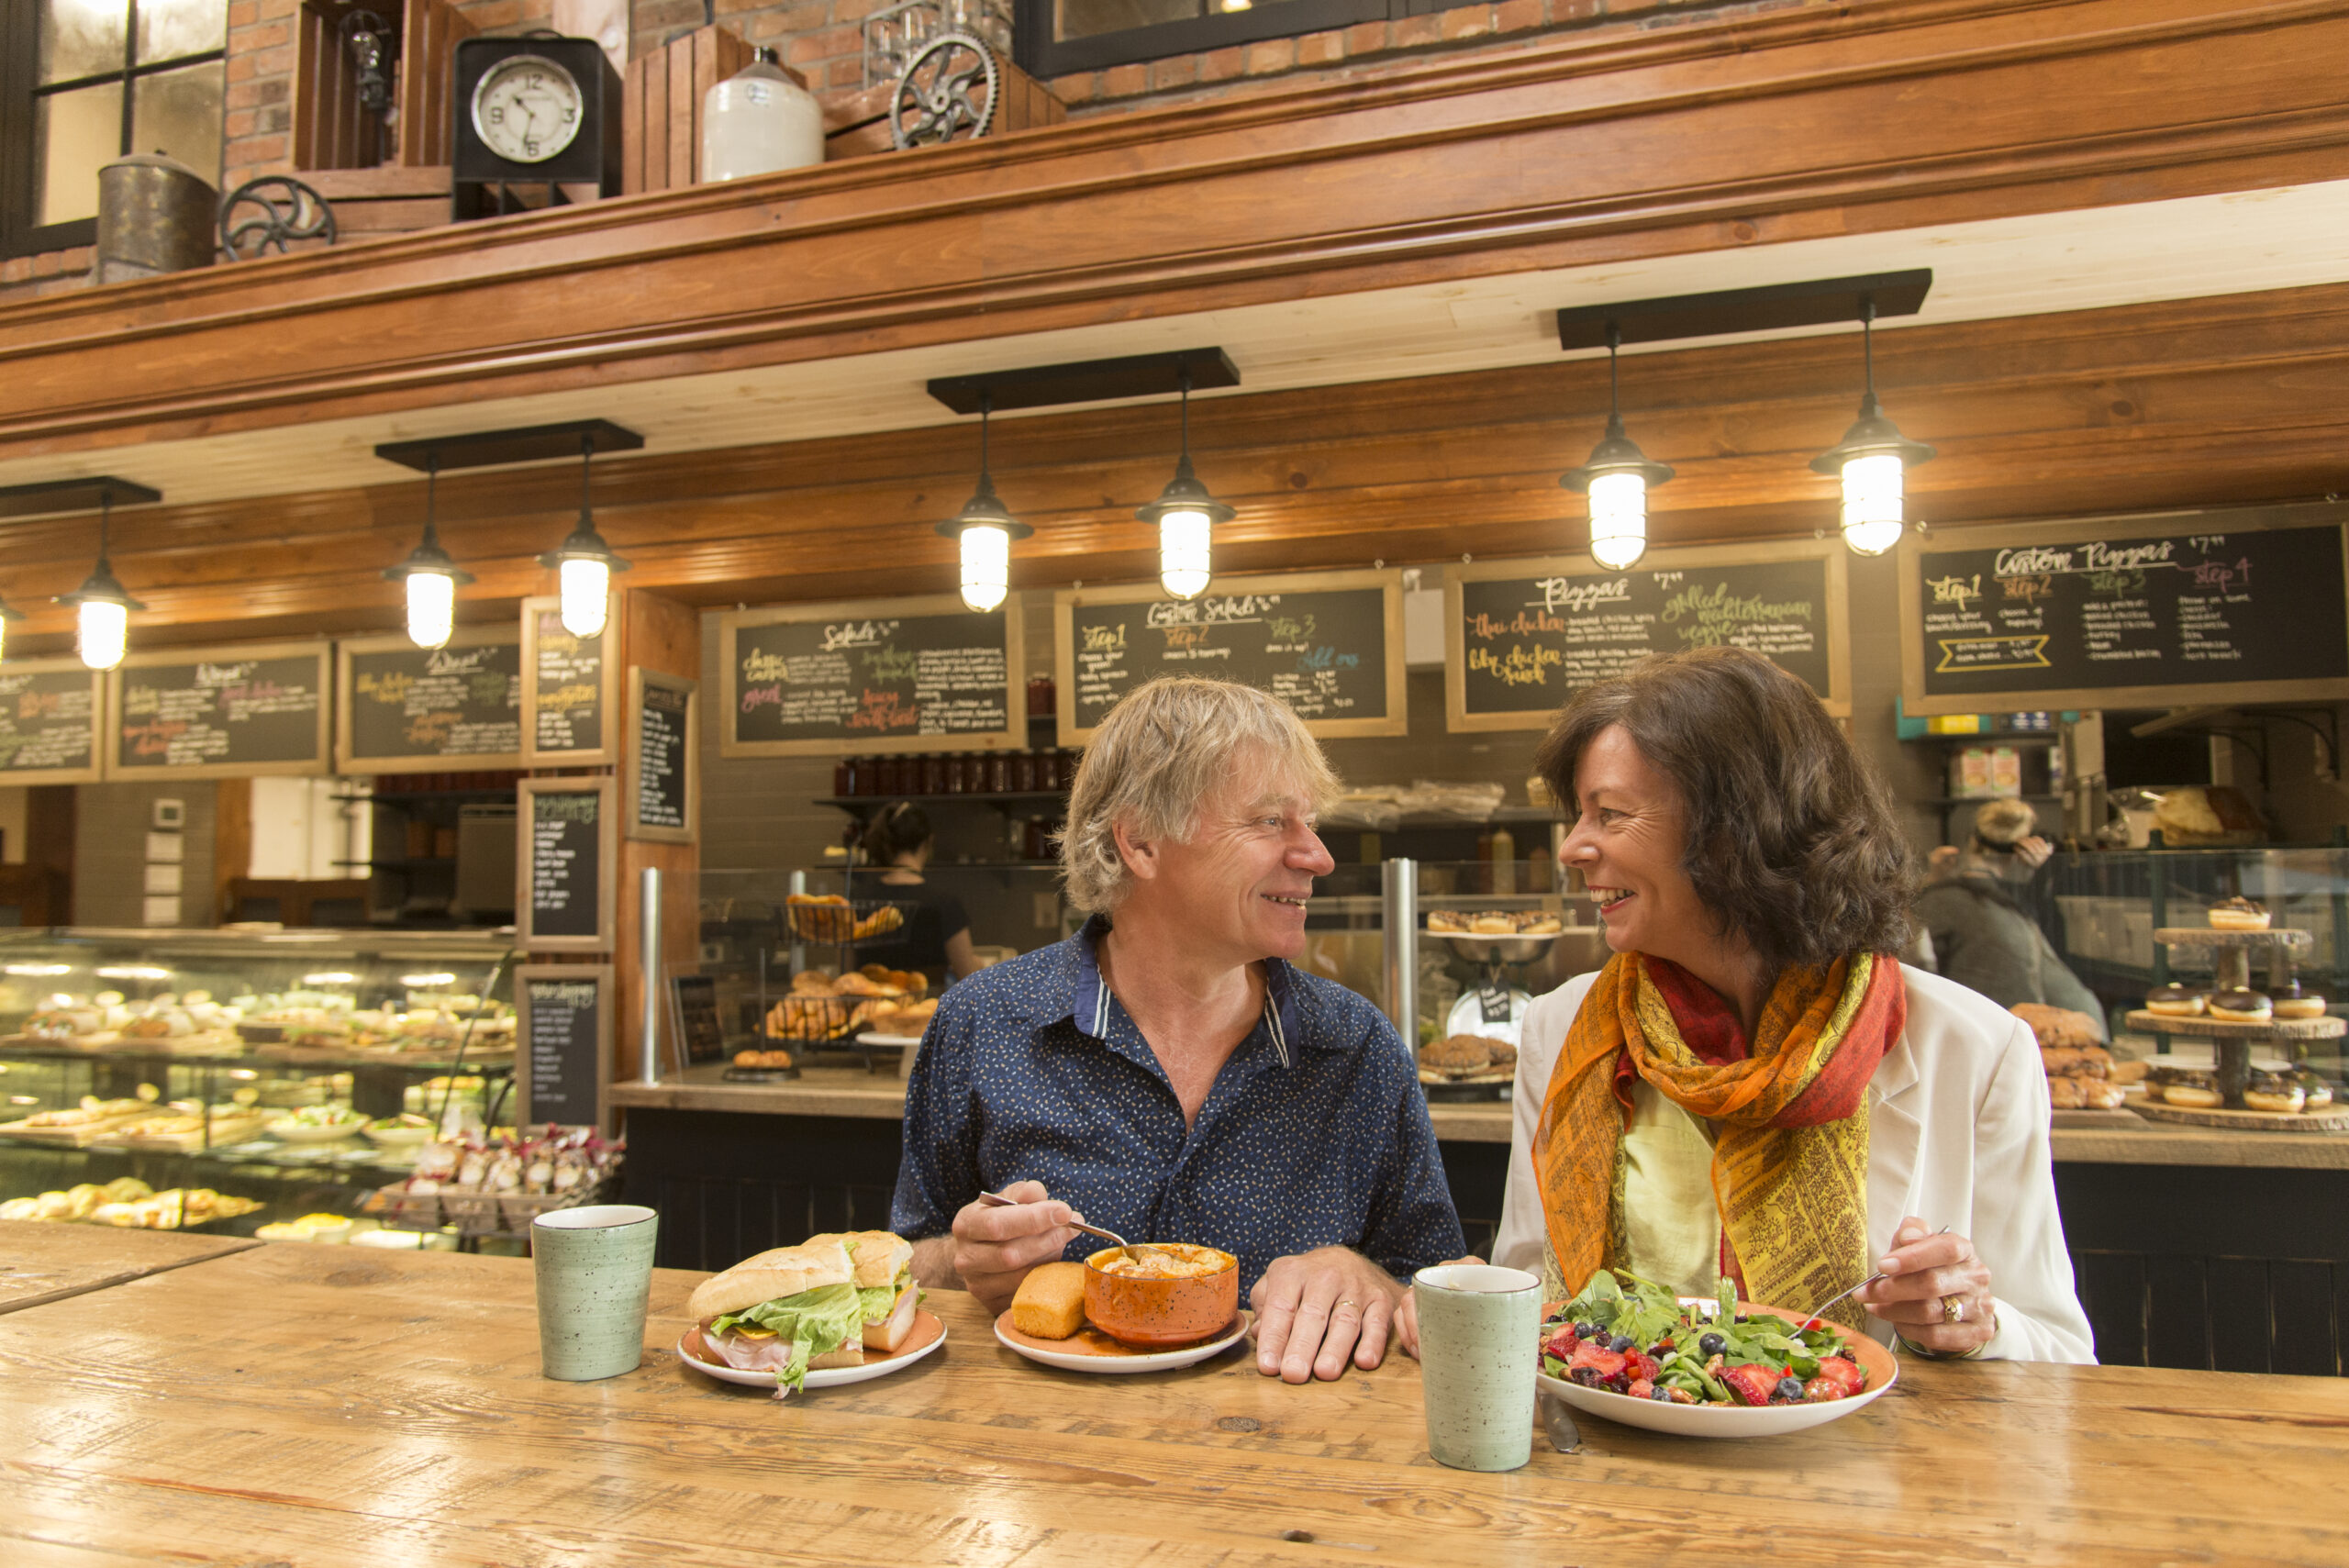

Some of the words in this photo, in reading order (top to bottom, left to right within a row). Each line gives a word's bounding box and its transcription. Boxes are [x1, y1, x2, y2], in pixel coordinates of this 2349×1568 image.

[526, 73, 543, 90] 12
[491, 106, 504, 124] 9
[562, 108, 575, 124] 3
[528, 140, 540, 157] 6
[1995, 547, 2072, 574] Custom
[2076, 540, 2176, 573] Pizzas
[1535, 577, 1630, 615] Pizzas
[1303, 613, 1317, 637] 3
